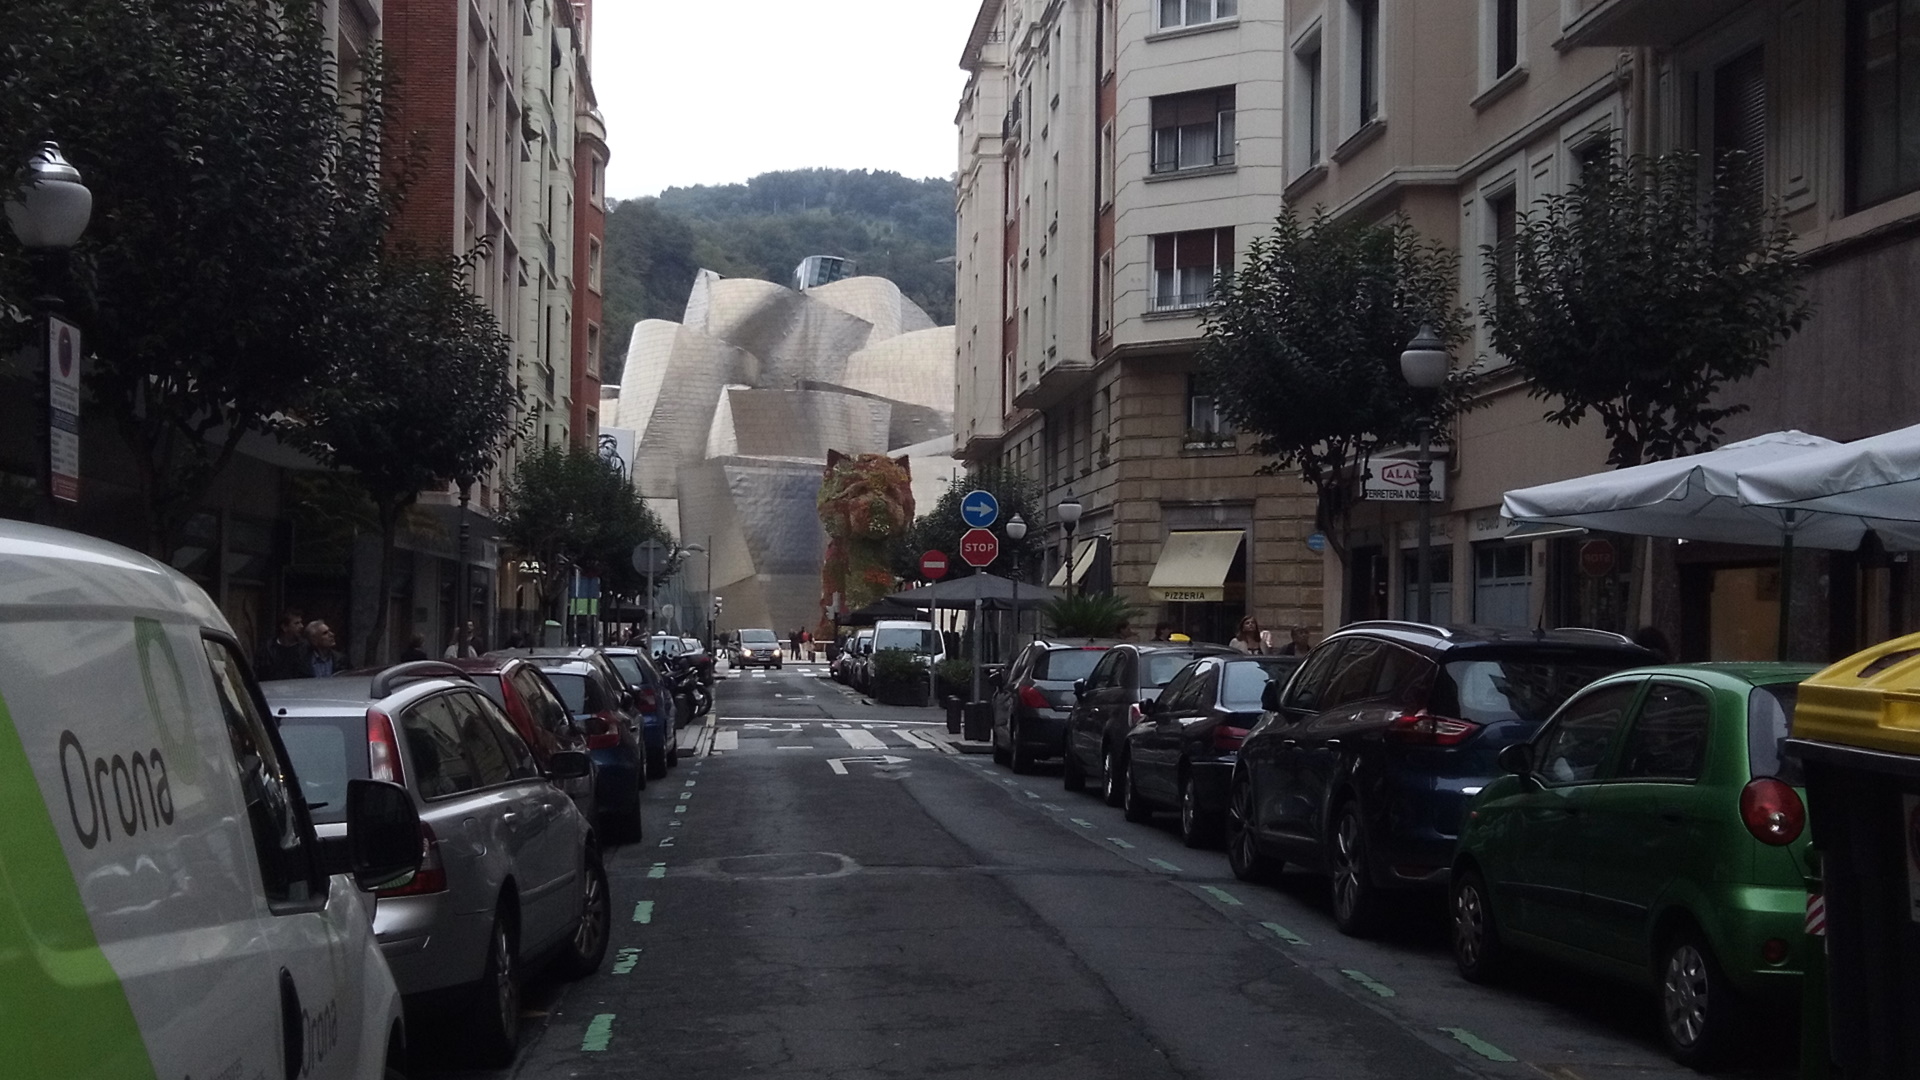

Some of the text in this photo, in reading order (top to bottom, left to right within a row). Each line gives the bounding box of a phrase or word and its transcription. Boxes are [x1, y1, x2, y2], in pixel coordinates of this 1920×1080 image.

[1405, 490, 1442, 500] INDUIAL
[964, 542, 995, 552] STOP
[1164, 591, 1205, 600] PIZZERIA
[59, 729, 174, 850] Orona
[300, 998, 338, 1079] Orona
